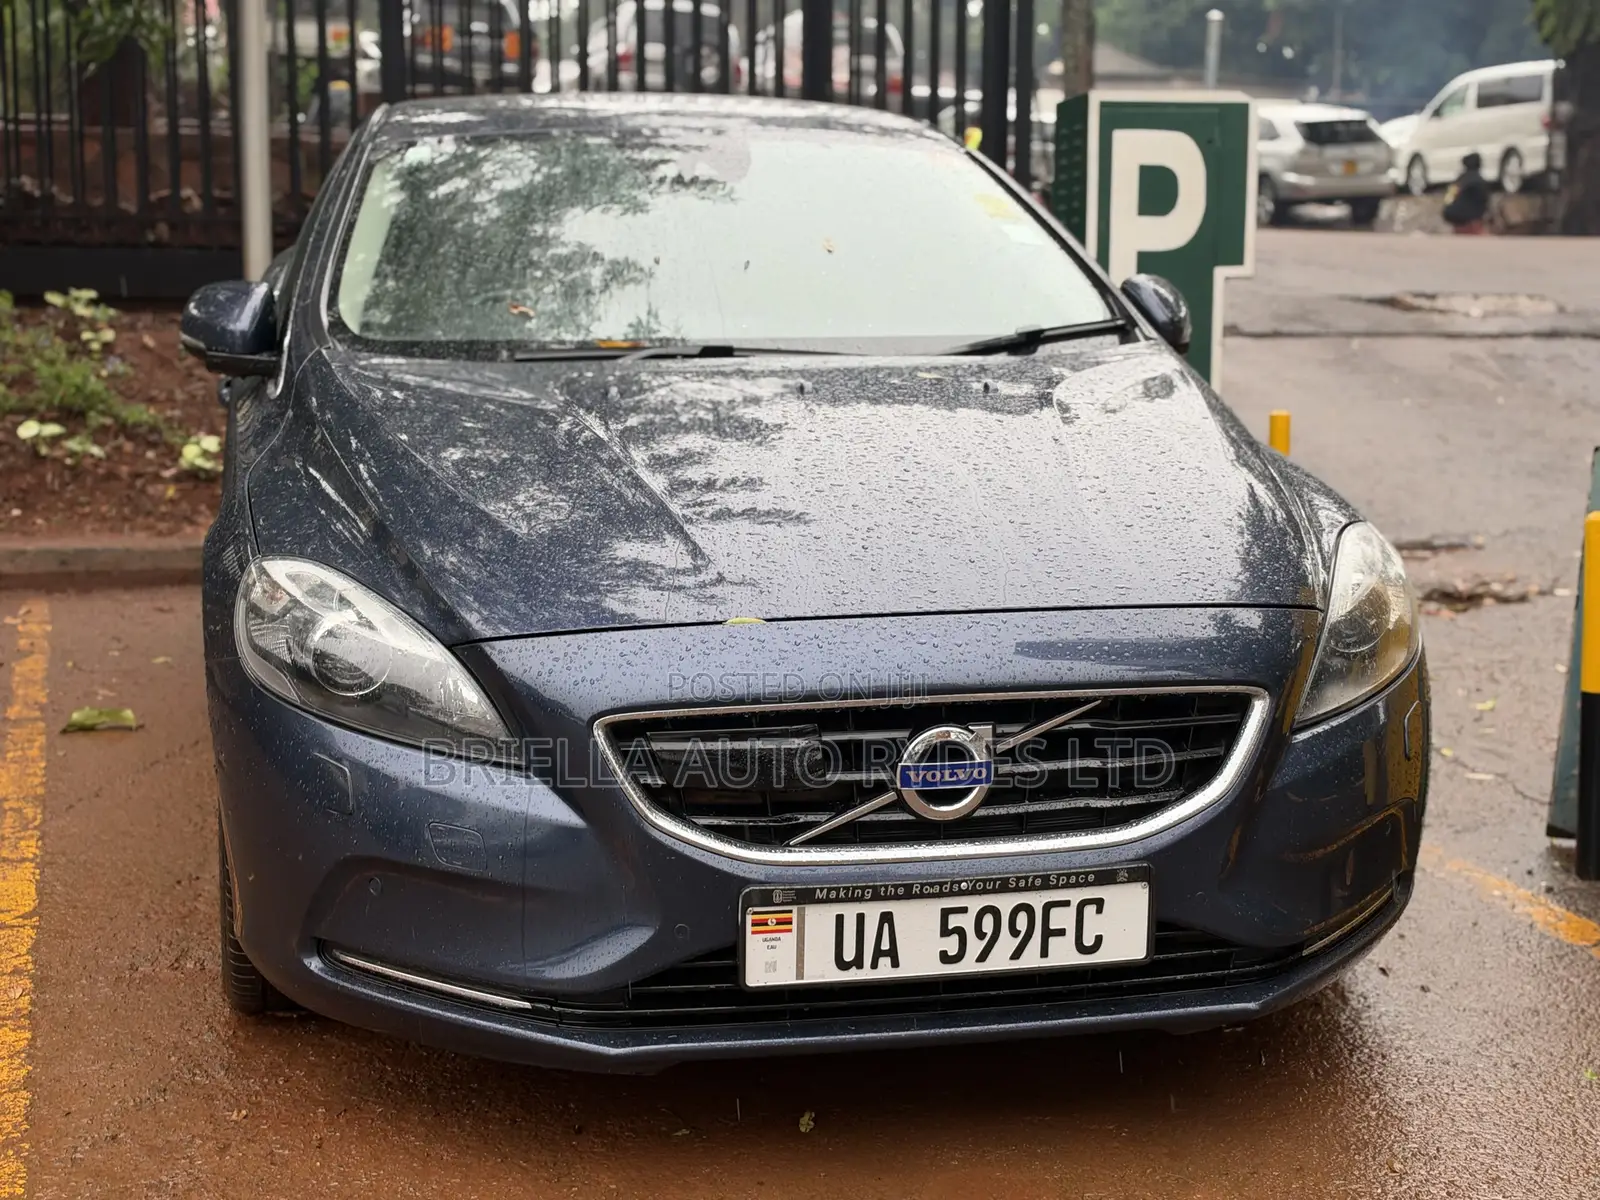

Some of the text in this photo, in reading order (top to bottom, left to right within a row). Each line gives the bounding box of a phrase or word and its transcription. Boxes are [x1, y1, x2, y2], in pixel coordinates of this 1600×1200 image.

[1108, 128, 1207, 290] P
[906, 767, 987, 783] VOLVO
[815, 873, 1095, 900] Making the Roads Your Safe Space
[834, 897, 1105, 971] UA 599FC
